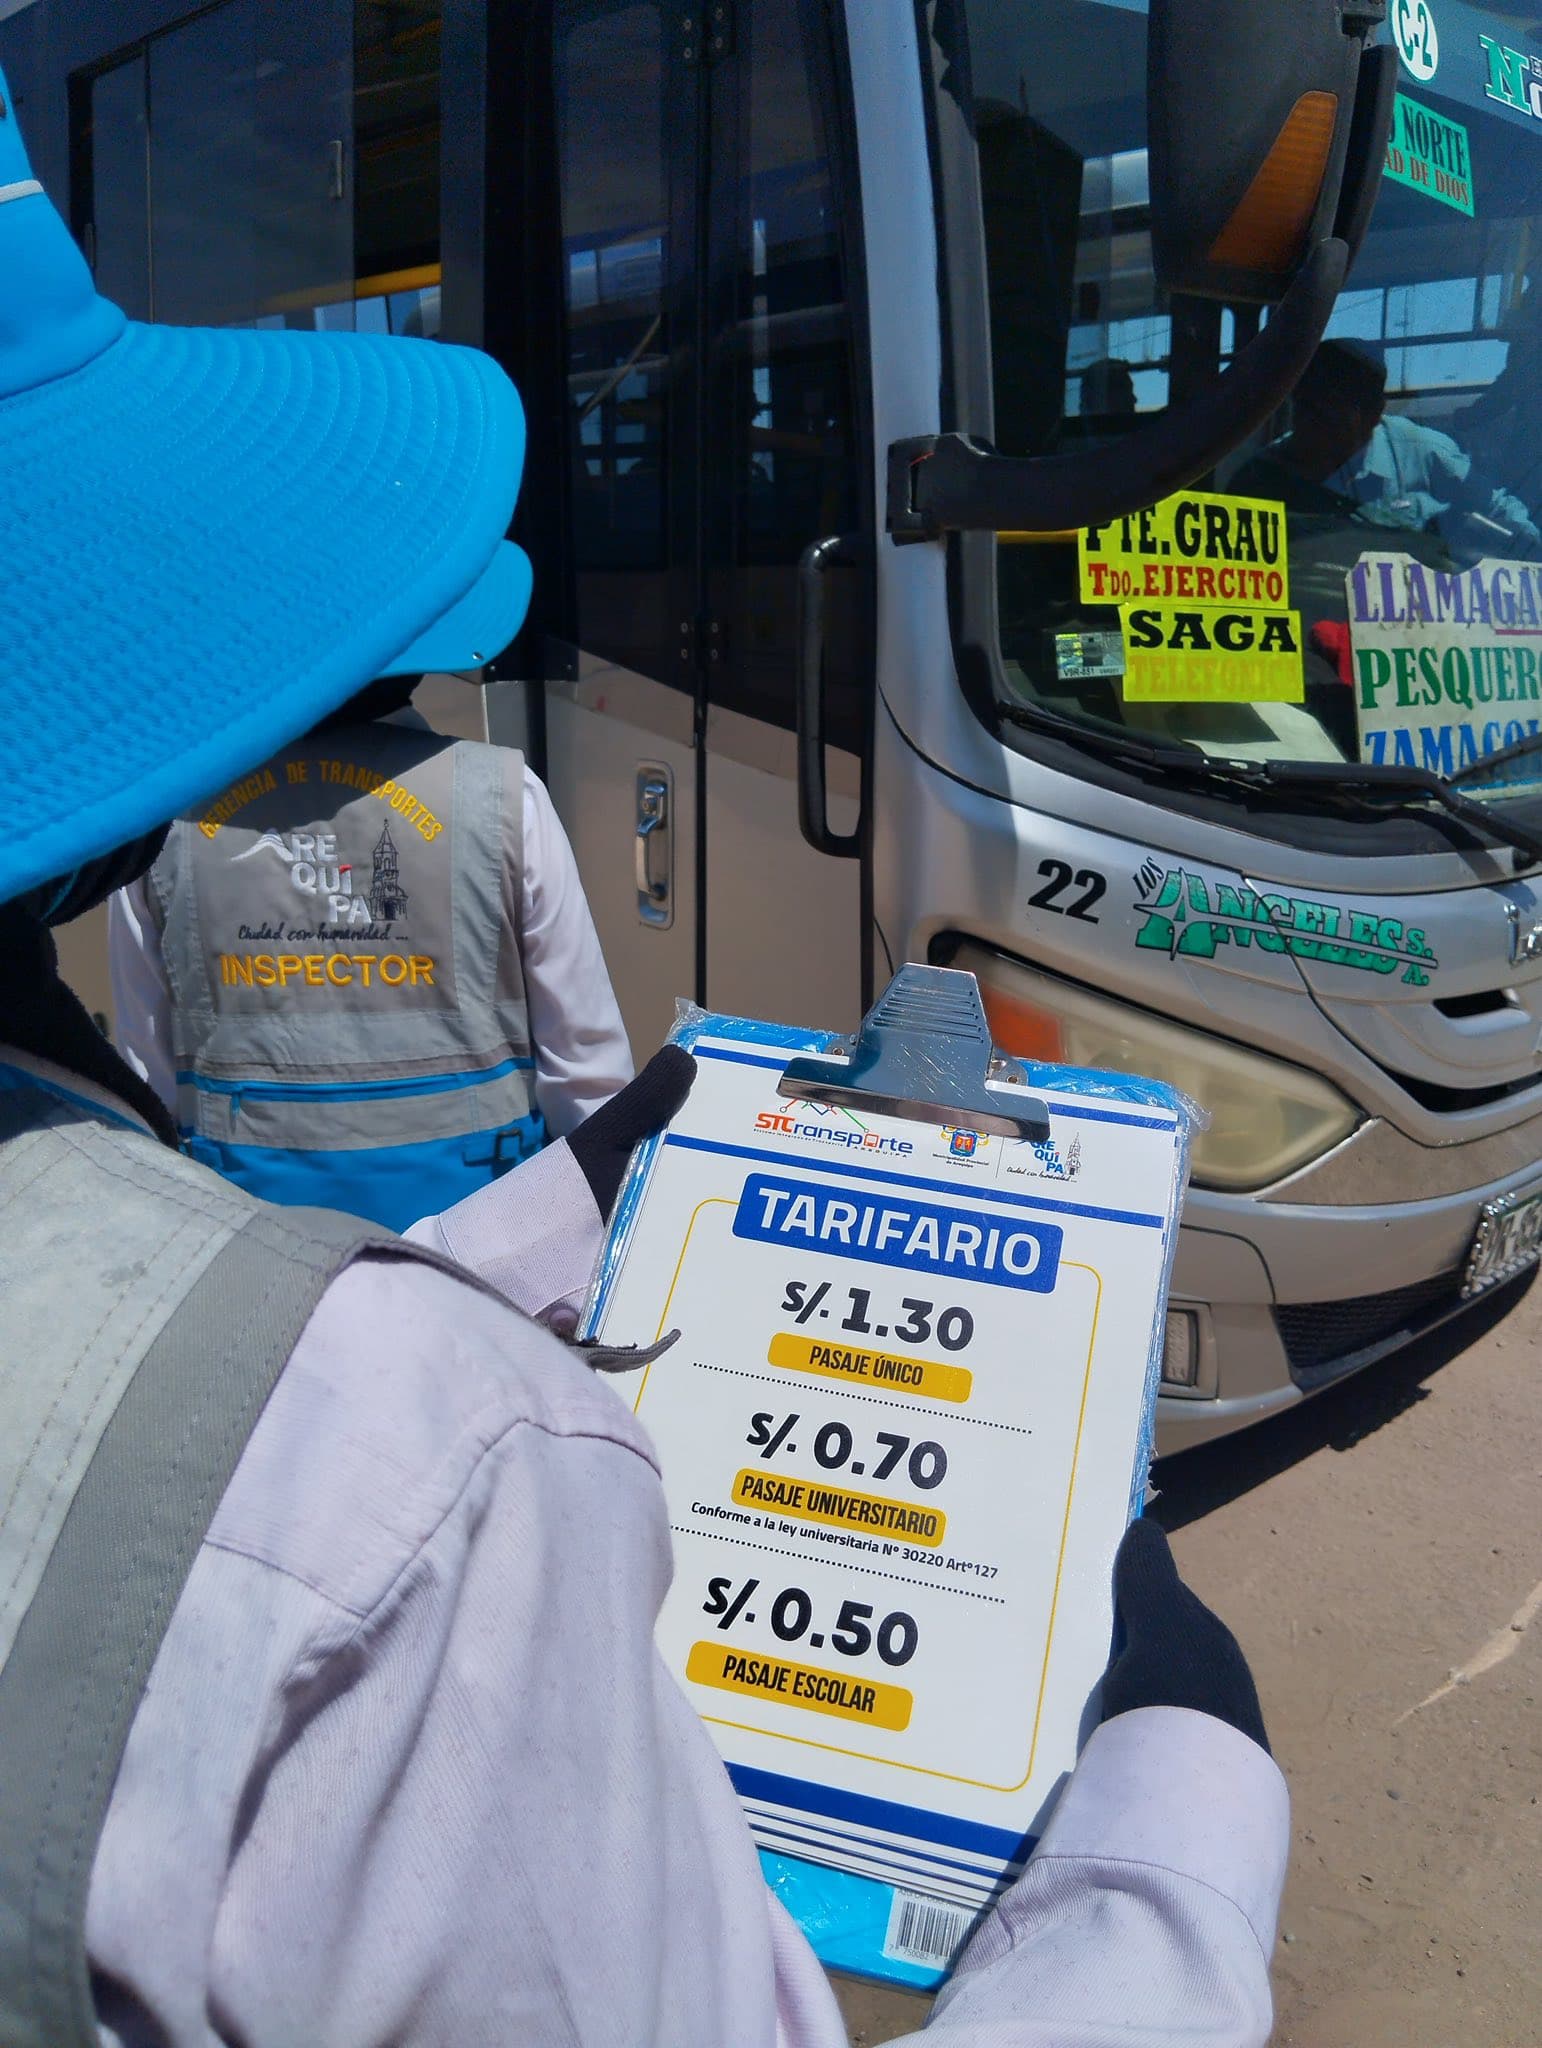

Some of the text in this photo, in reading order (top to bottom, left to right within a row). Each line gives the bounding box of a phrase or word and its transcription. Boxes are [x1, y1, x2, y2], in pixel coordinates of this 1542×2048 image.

[1401, 102, 1467, 179] NORTE
[1435, 168, 1469, 206] DIOS
[1352, 561, 1542, 626] LLAMAGA
[1128, 609, 1298, 653] SAGA
[1356, 647, 1542, 710] PESQUER
[286, 761, 309, 785] DE
[319, 759, 444, 843] TRANSPORTES
[328, 894, 373, 923] PA
[1027, 858, 1107, 924] 22
[1131, 856, 1165, 900] LOS
[1134, 866, 1403, 975] ANGELES
[219, 953, 437, 989] INSPECTOR
[757, 1187, 1041, 1276] TARIFARIO
[841, 1287, 974, 1352] 1.30
[809, 1345, 924, 1387] PASAJE ÚNICO
[813, 1420, 948, 1491] 0.70
[691, 1500, 752, 1526] Conforme
[753, 1516, 762, 1528] a
[763, 1516, 776, 1531] la
[778, 1519, 797, 1538] ley
[799, 1526, 880, 1554] universitaria
[901, 1547, 945, 1568] 30220
[740, 1474, 938, 1538] PASAJE UNIVERSITARIO
[770, 1587, 919, 1667] 0.50
[722, 1654, 877, 1713] PASAJE ESCOLAR
